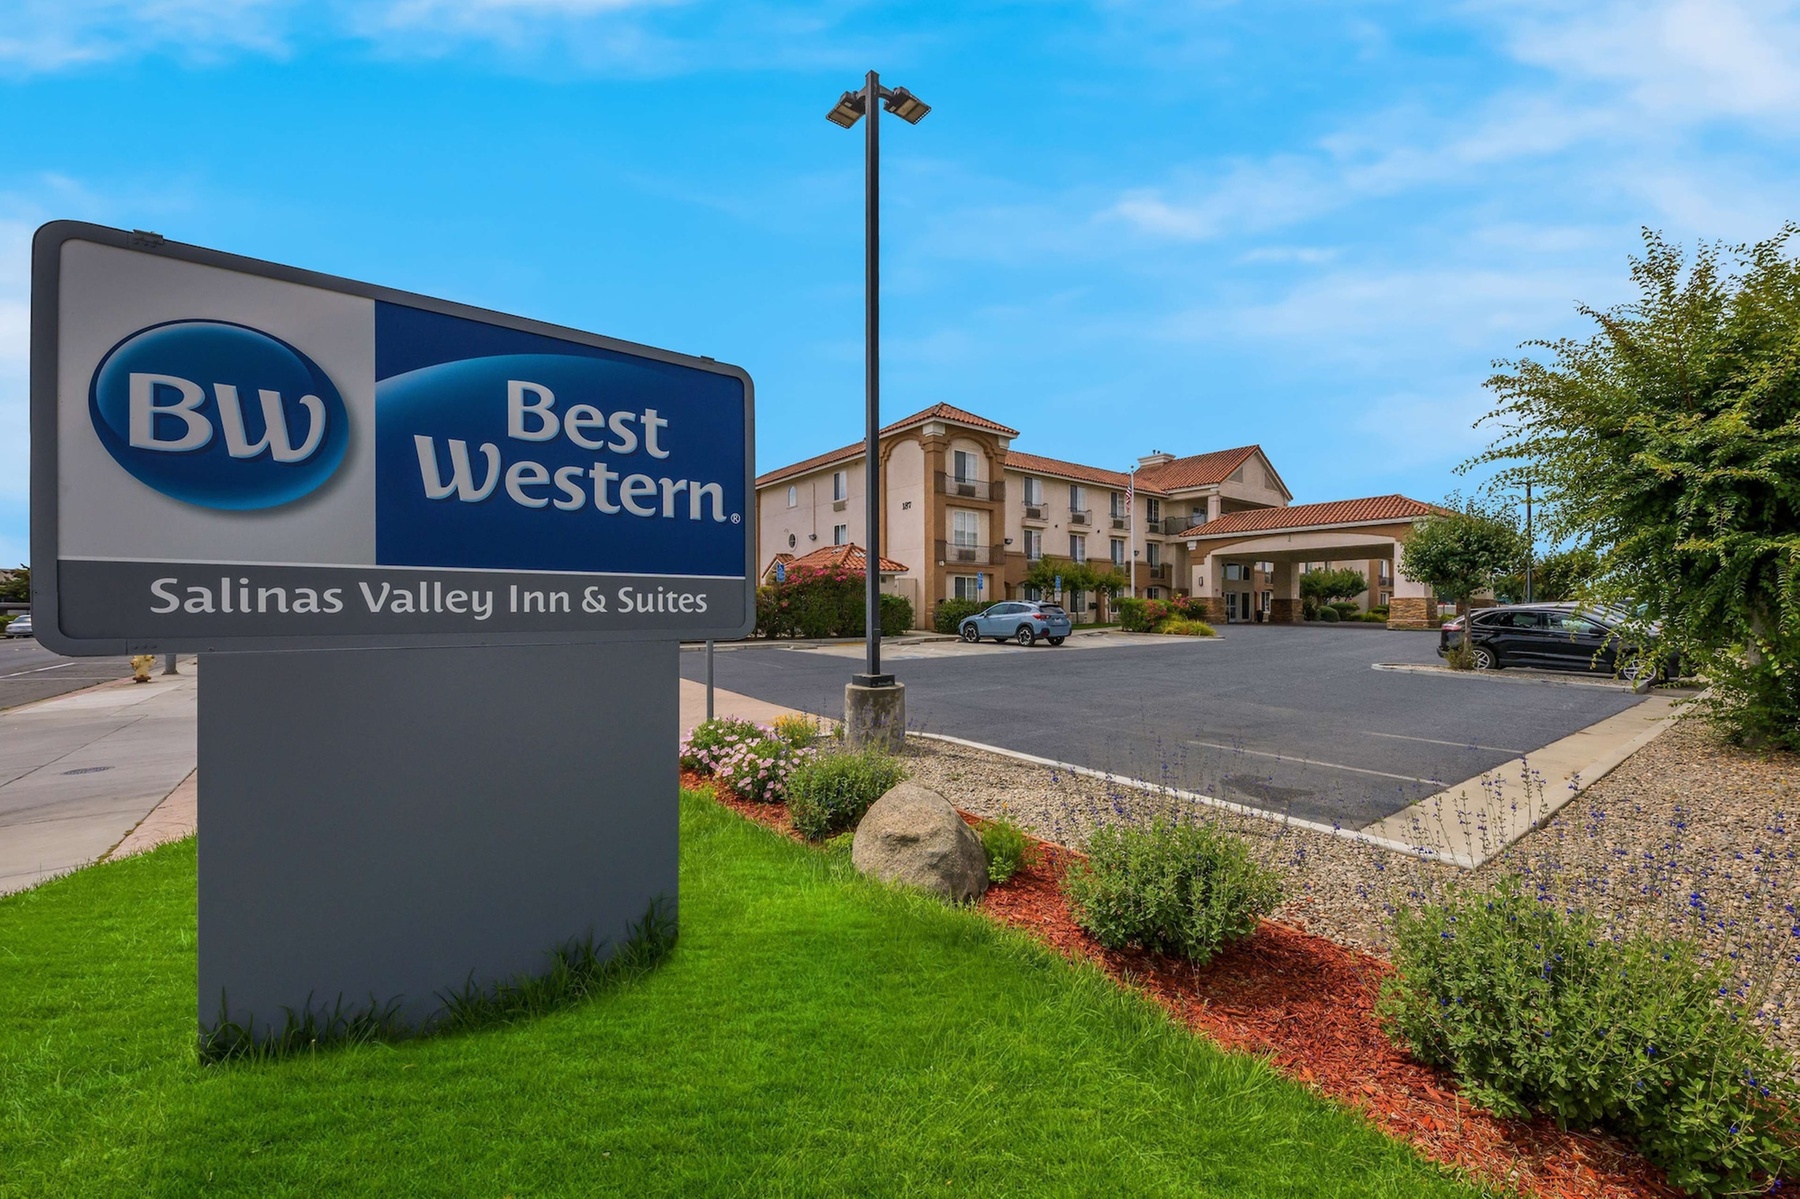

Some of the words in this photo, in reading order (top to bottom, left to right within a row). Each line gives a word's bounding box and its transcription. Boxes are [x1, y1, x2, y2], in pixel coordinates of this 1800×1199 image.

[128, 372, 326, 463] BW
[506, 380, 670, 458] Best
[150, 577, 344, 614] Salinas
[358, 581, 493, 621] Valley
[510, 584, 571, 613] Inn
[581, 585, 608, 613] &
[617, 586, 708, 613] Suites
